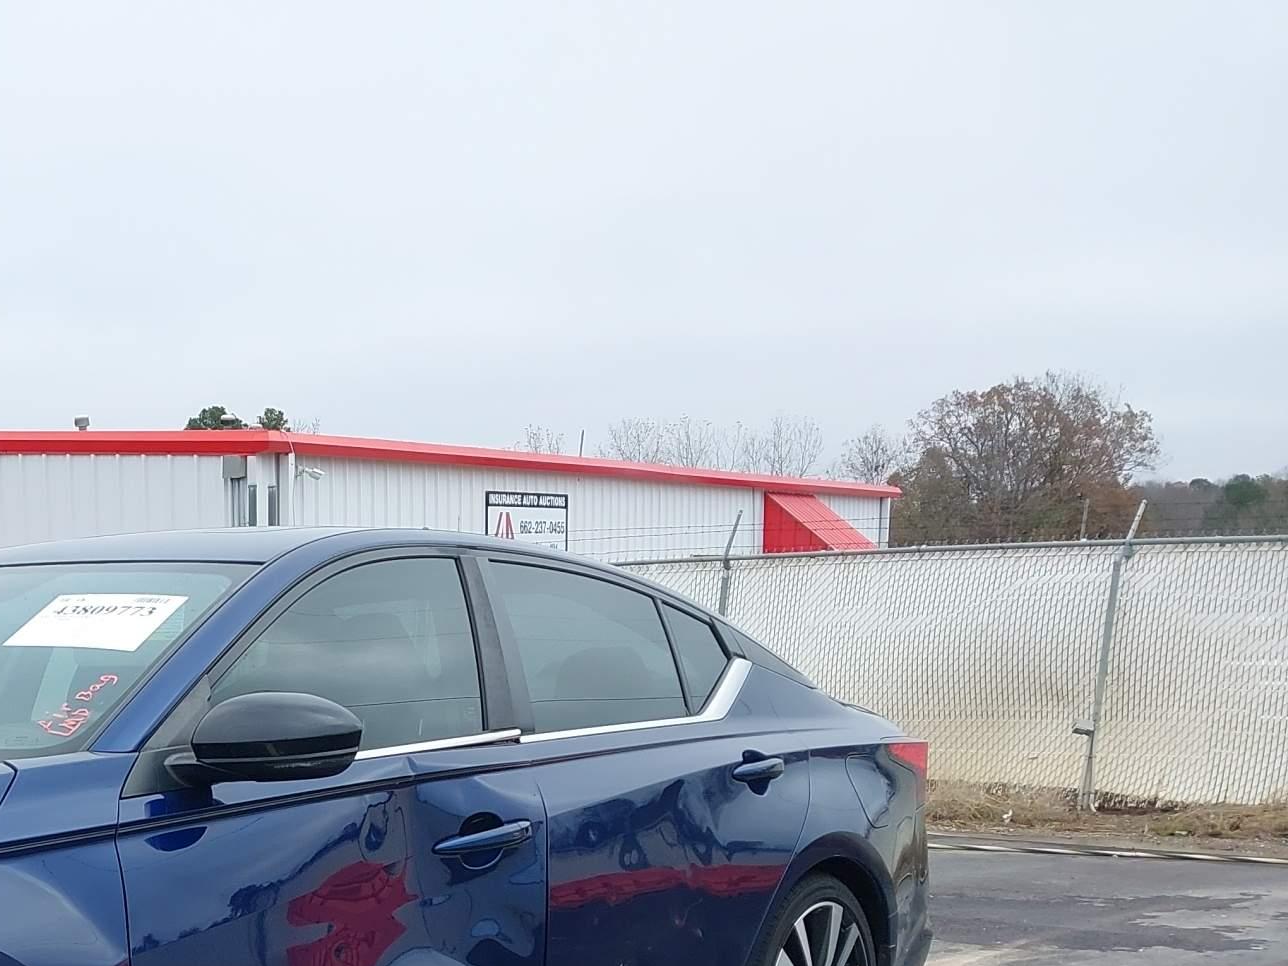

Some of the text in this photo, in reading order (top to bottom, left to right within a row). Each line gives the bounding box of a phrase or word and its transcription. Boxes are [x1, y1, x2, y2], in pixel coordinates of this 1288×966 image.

[488, 493, 566, 507] INSURANCE AUTO AUCTIONS
[519, 520, 565, 534] 662-237-0455
[52, 604, 158, 617] 43809773
[75, 675, 118, 701] Bag
